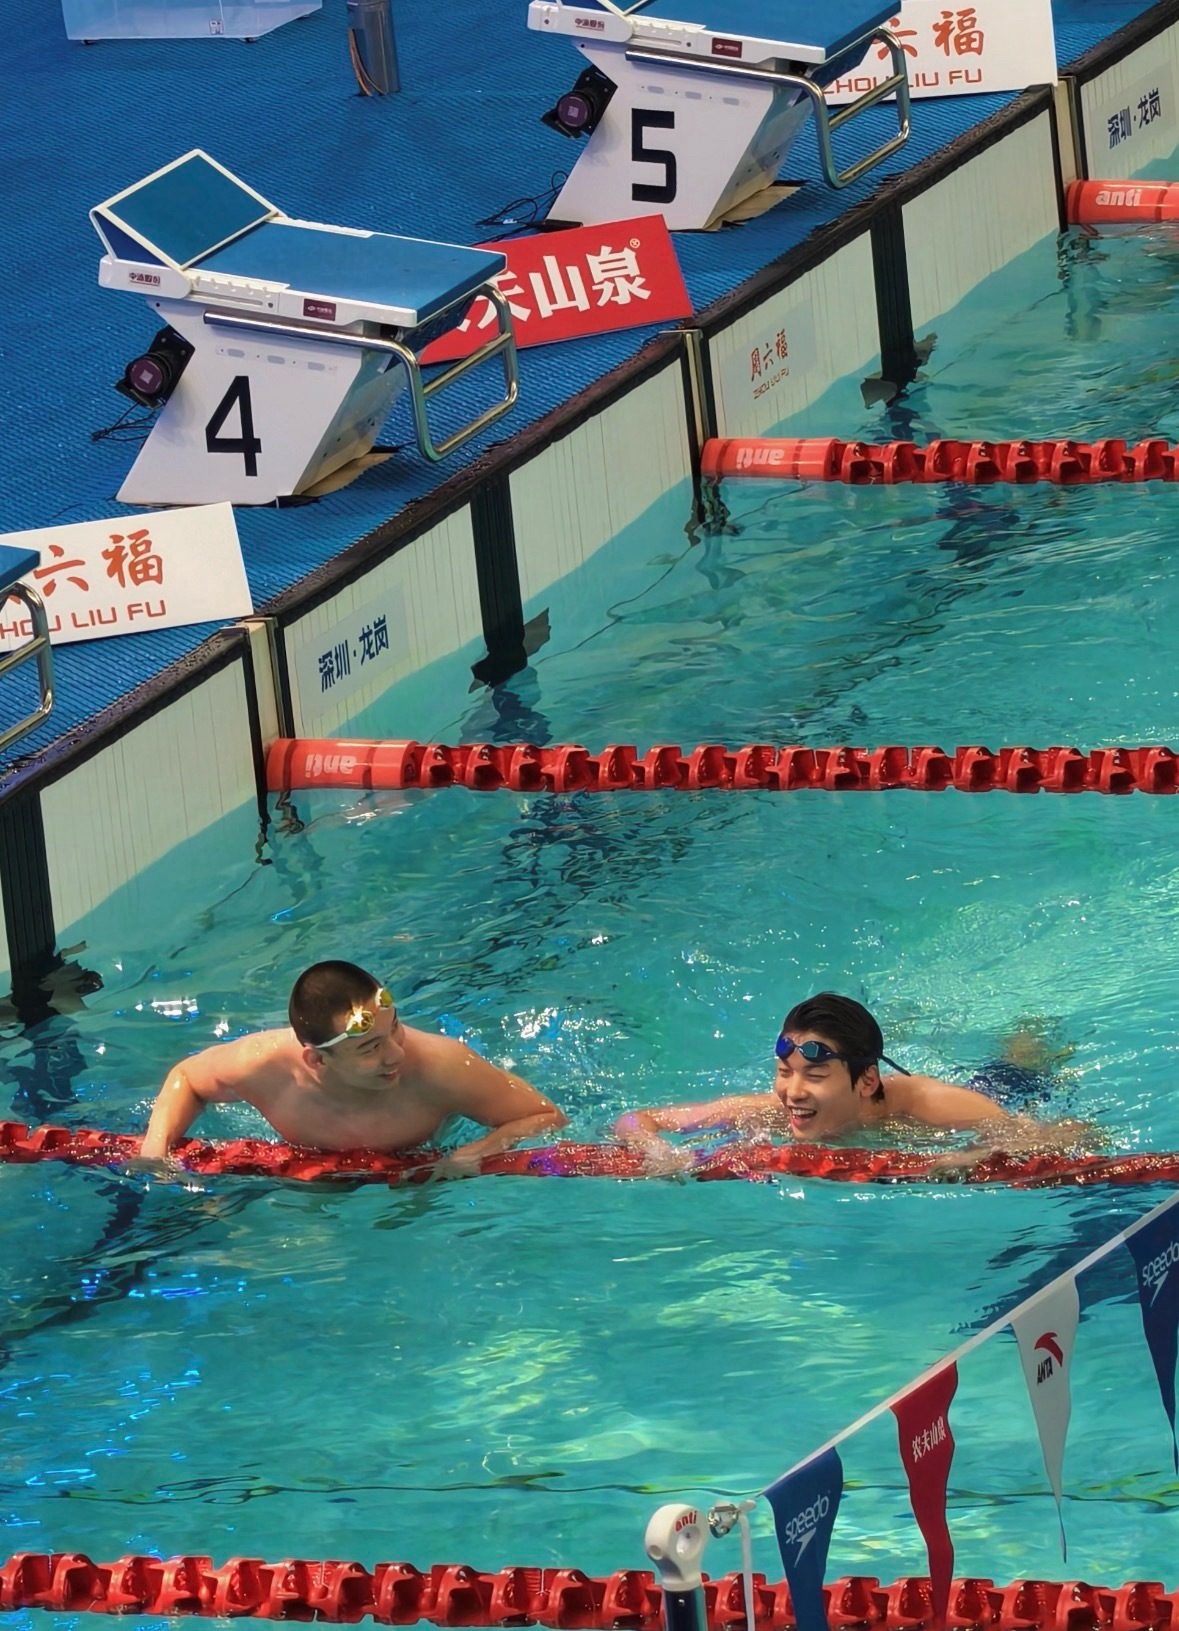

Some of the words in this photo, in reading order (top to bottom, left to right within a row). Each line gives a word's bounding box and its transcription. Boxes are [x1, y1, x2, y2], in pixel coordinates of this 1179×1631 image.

[949, 69, 982, 84] FU
[631, 108, 677, 204] 5
[1096, 189, 1142, 206] anti
[457, 245, 651, 332] 夫山泉
[205, 375, 262, 477] 4
[736, 447, 785, 470] anti
[8, 529, 163, 605] 六福
[71, 607, 117, 628] LIU
[127, 600, 166, 621] FU
[305, 753, 357, 778] anti
[1142, 1240, 1179, 1288] speedo
[1036, 1356, 1053, 1386] ANTA
[675, 1510, 697, 1532] anti
[785, 1494, 830, 1545] speedo
